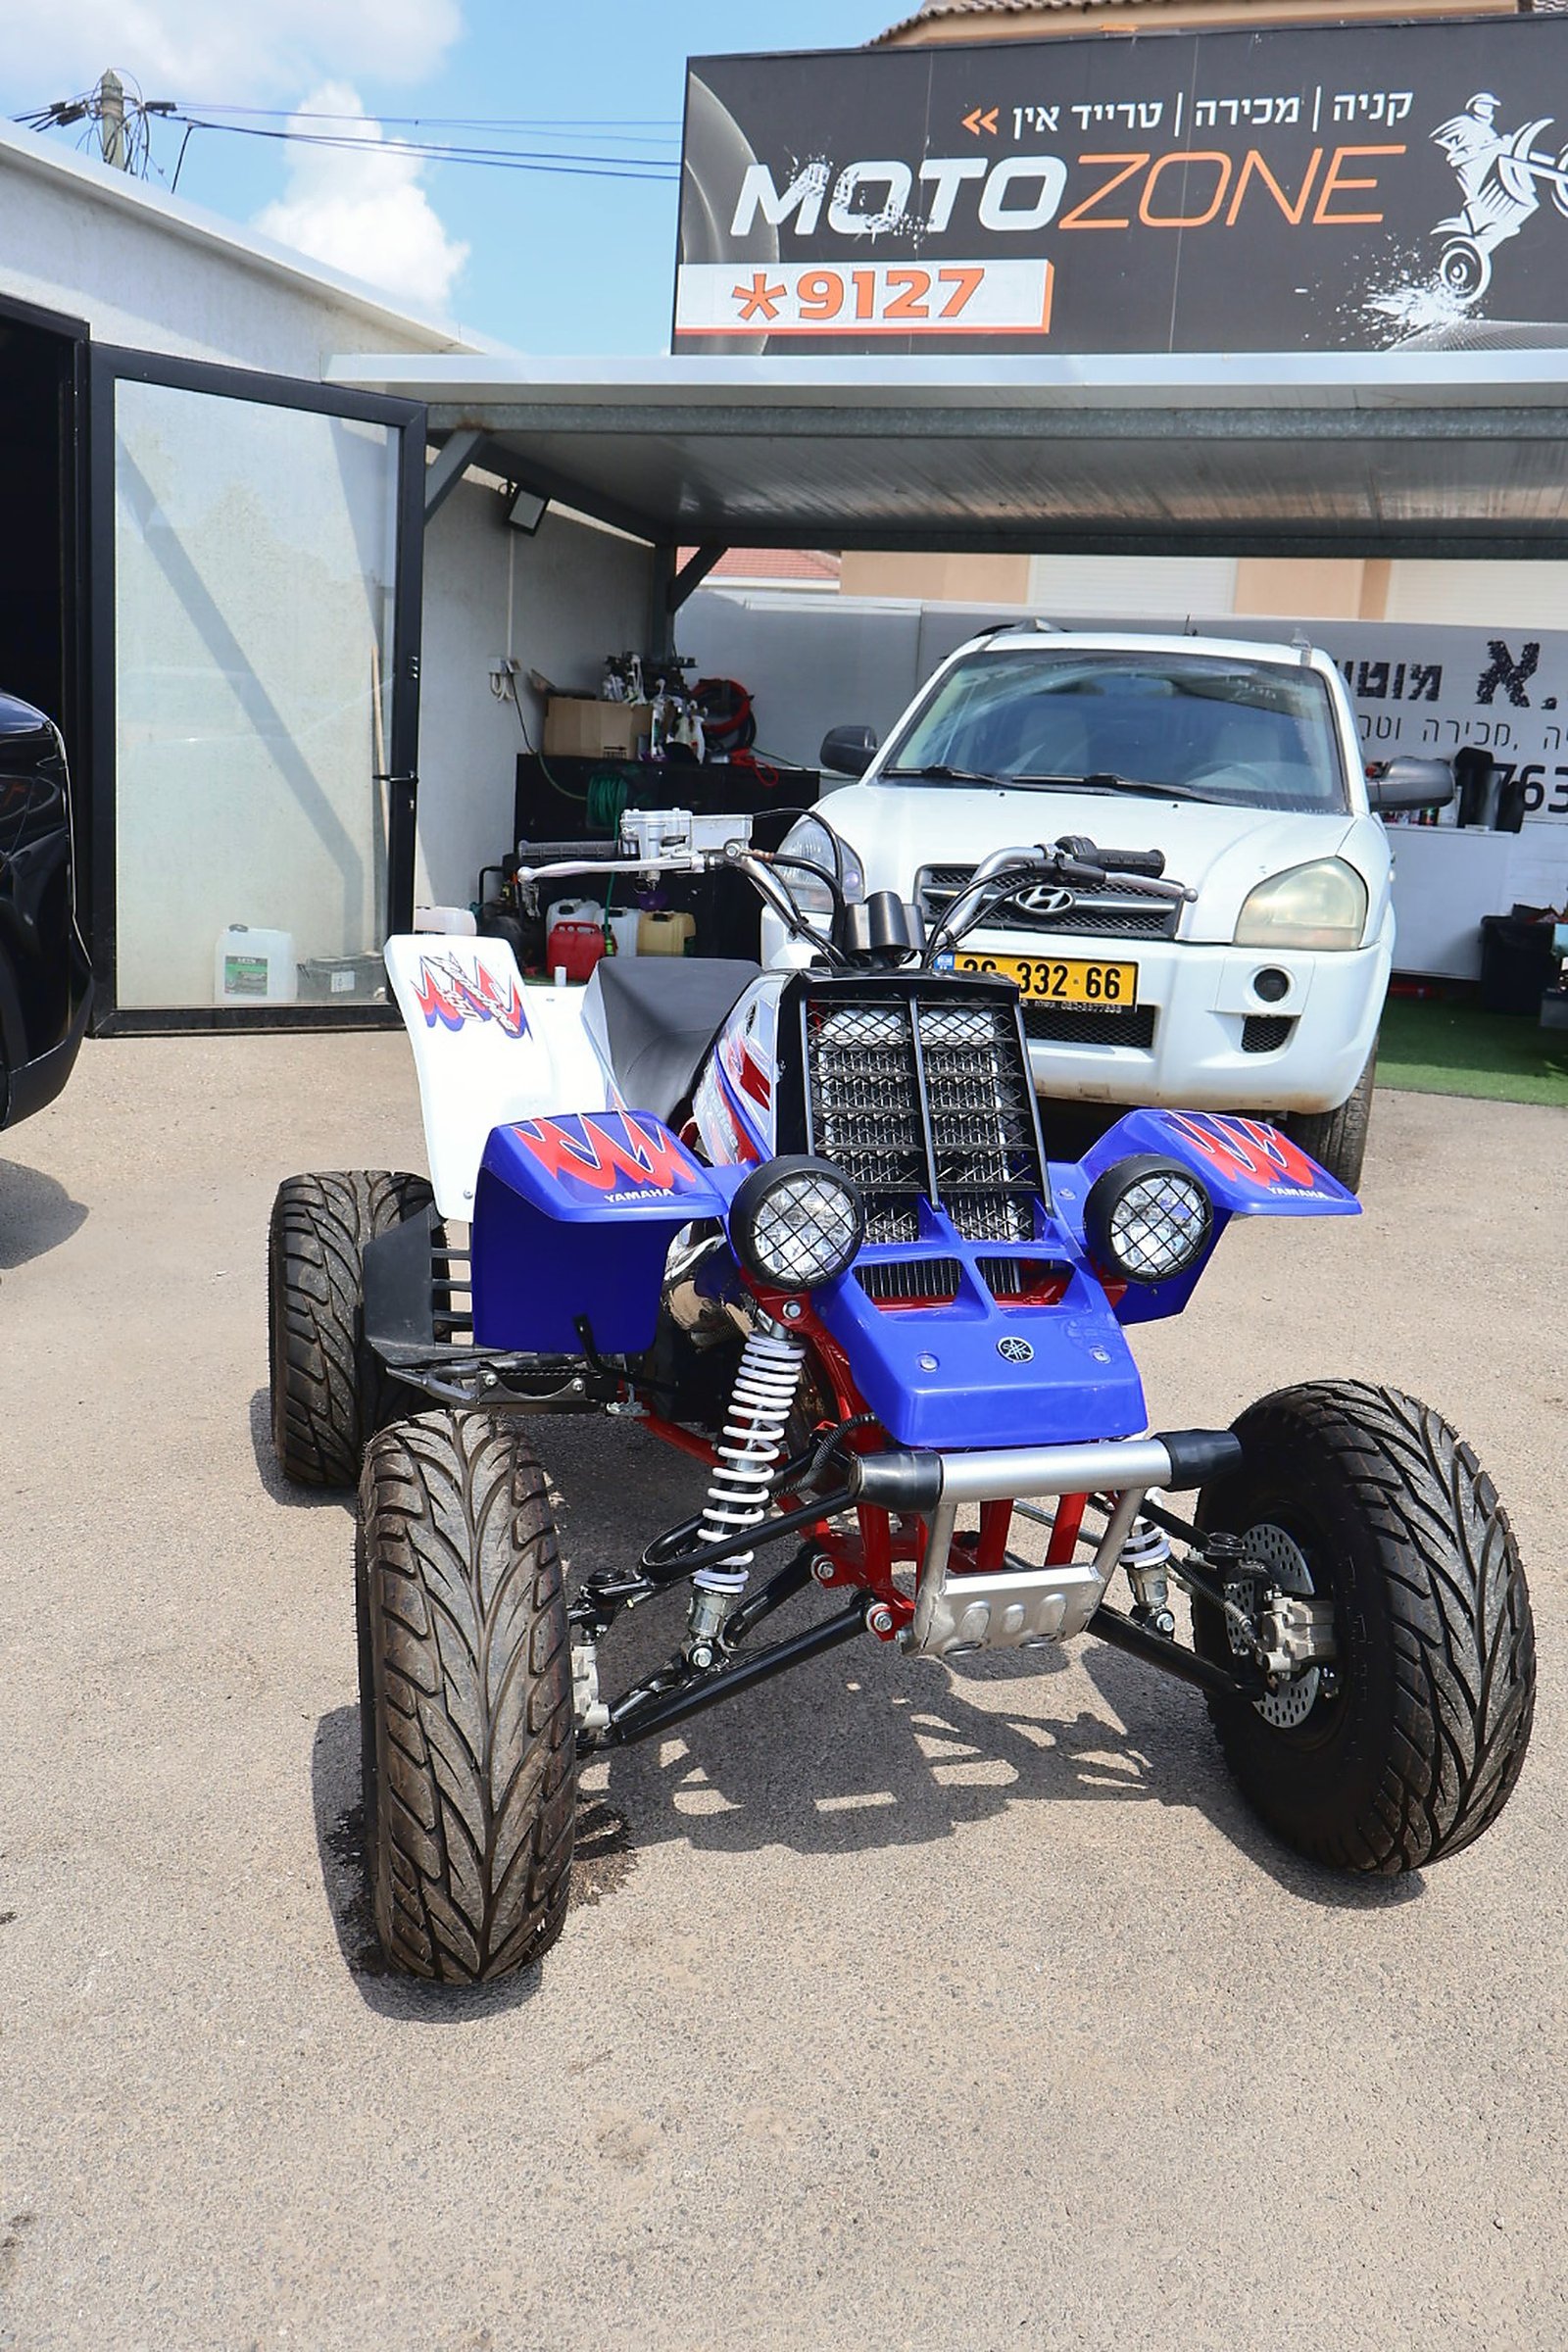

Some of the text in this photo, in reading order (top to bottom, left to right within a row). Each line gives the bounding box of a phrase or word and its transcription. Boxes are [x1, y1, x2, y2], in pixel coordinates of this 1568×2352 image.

[1012, 92, 1413, 139] קניה מכירה טרייד אין
[1333, 661, 1443, 702] מוטו
[604, 1187, 674, 1203] YAMAHA
[1267, 1187, 1328, 1200] YAMAHA
